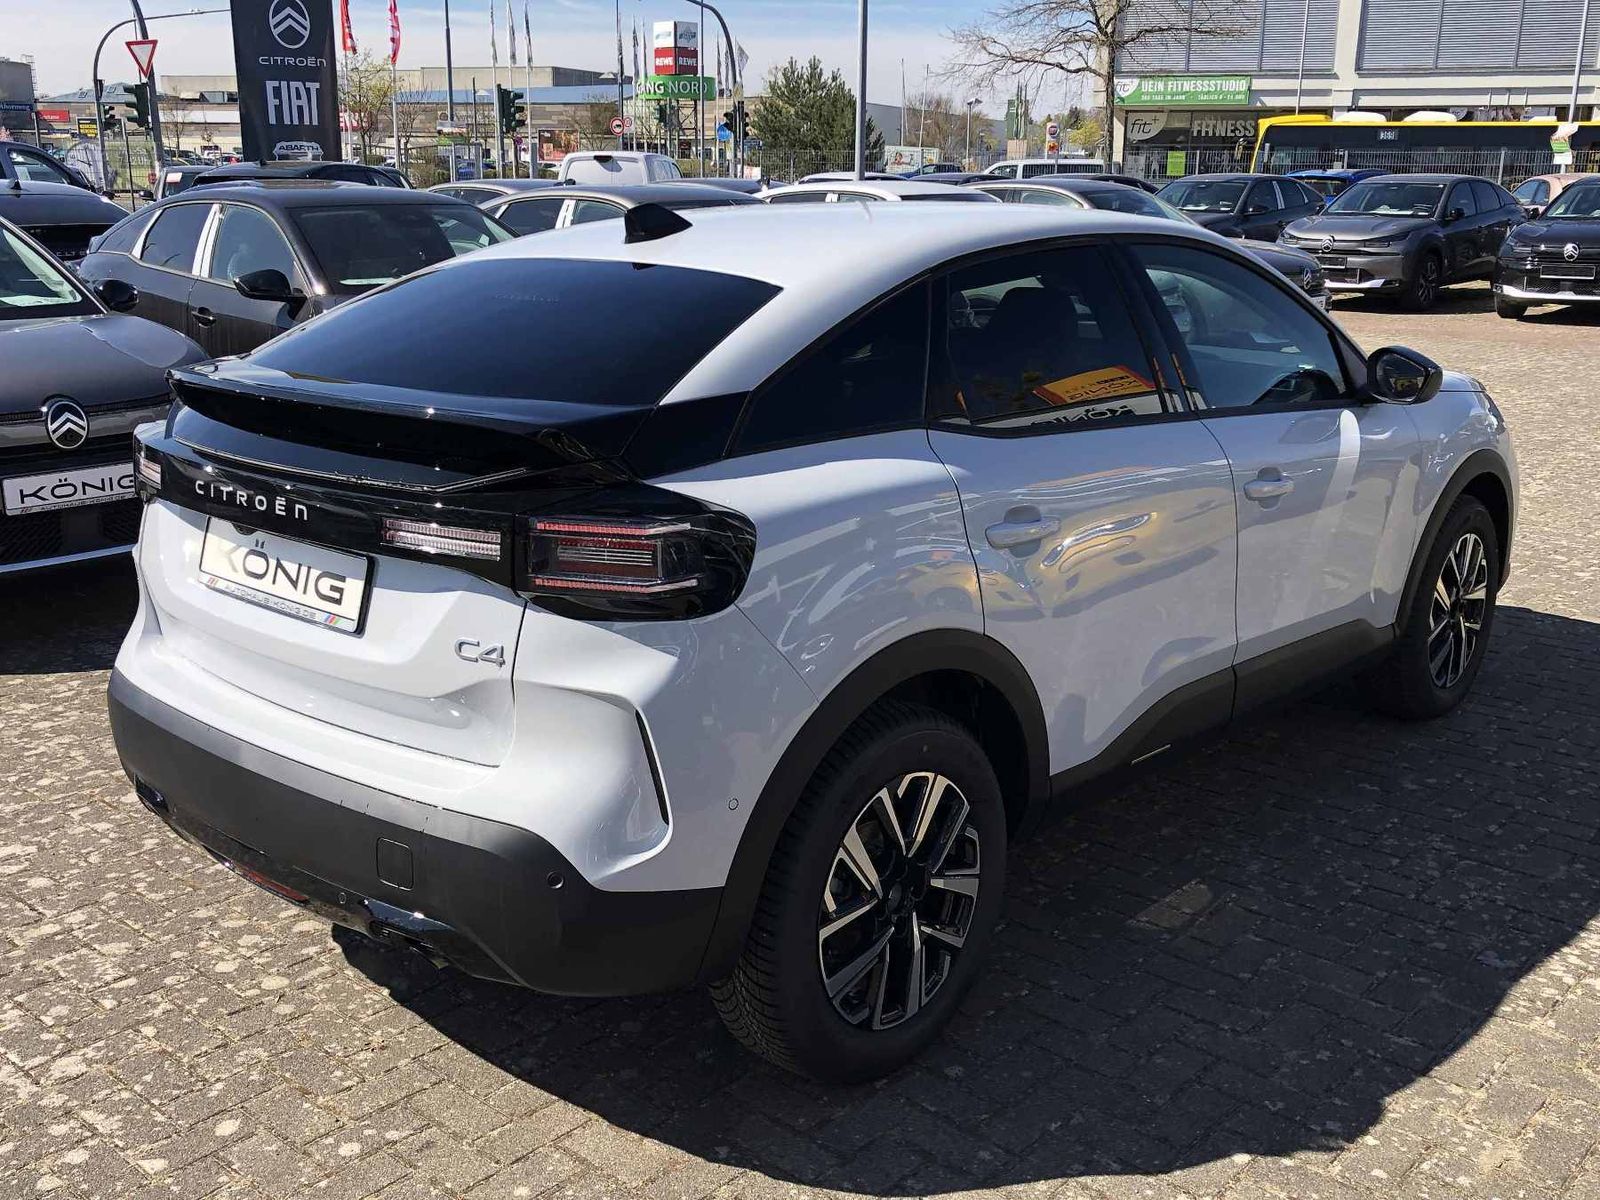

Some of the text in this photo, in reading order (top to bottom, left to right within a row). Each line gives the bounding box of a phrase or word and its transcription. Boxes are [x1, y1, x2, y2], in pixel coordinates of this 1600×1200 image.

[655, 57, 674, 66] REWE
[678, 57, 697, 66] REWE
[1167, 79, 1247, 92] FITNESSSTUDIO
[265, 80, 320, 126] FIAT
[1193, 119, 1255, 137] FITNESS
[278, 143, 319, 152] ABARTH
[19, 473, 134, 504] KÖNIG
[195, 480, 309, 521] CITROËN
[215, 539, 347, 606] KÖNIG
[454, 638, 506, 668] C4
